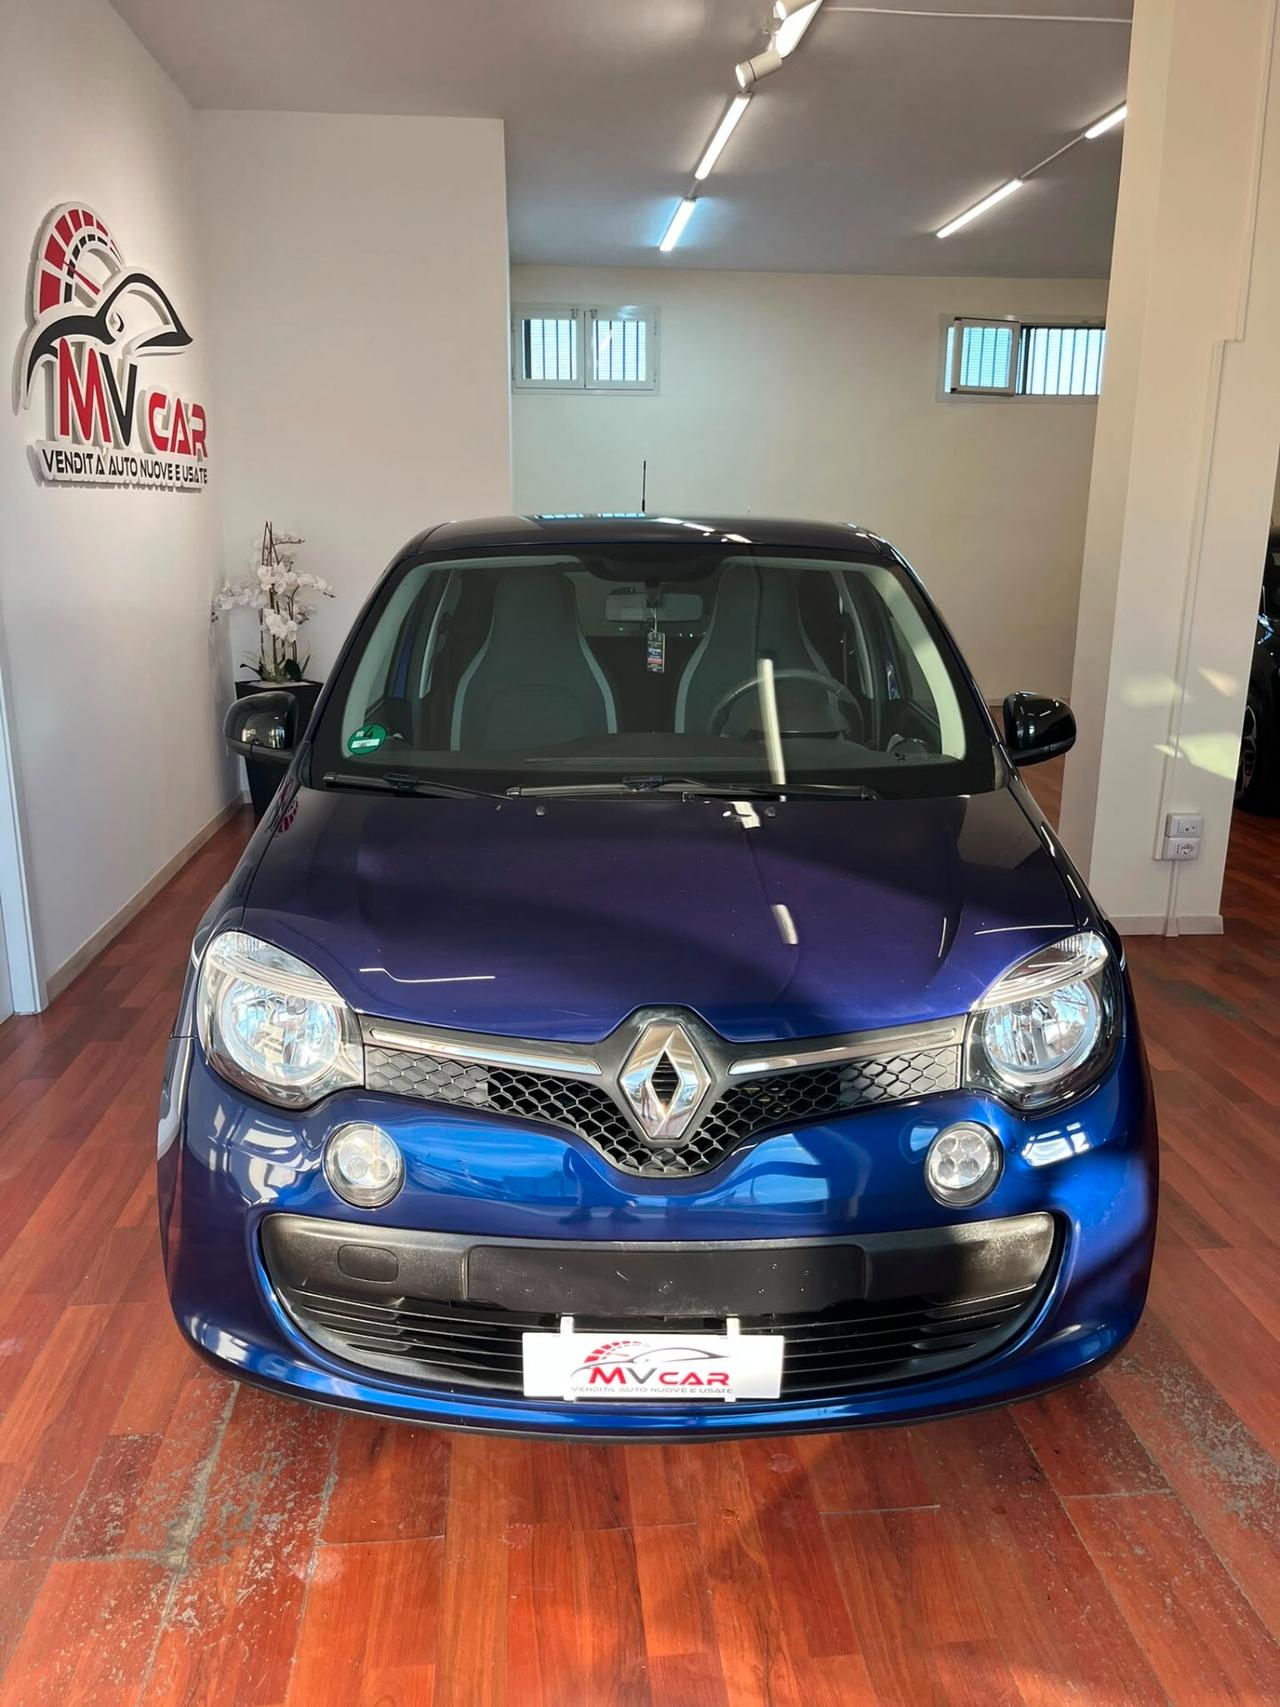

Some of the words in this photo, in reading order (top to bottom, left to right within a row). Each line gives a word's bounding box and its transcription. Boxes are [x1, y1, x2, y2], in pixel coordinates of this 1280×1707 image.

[149, 392, 208, 458] CAR
[108, 453, 138, 477] AUTO
[140, 458, 173, 480] NUOVE
[175, 463, 181, 482] E
[182, 466, 208, 484] USATE
